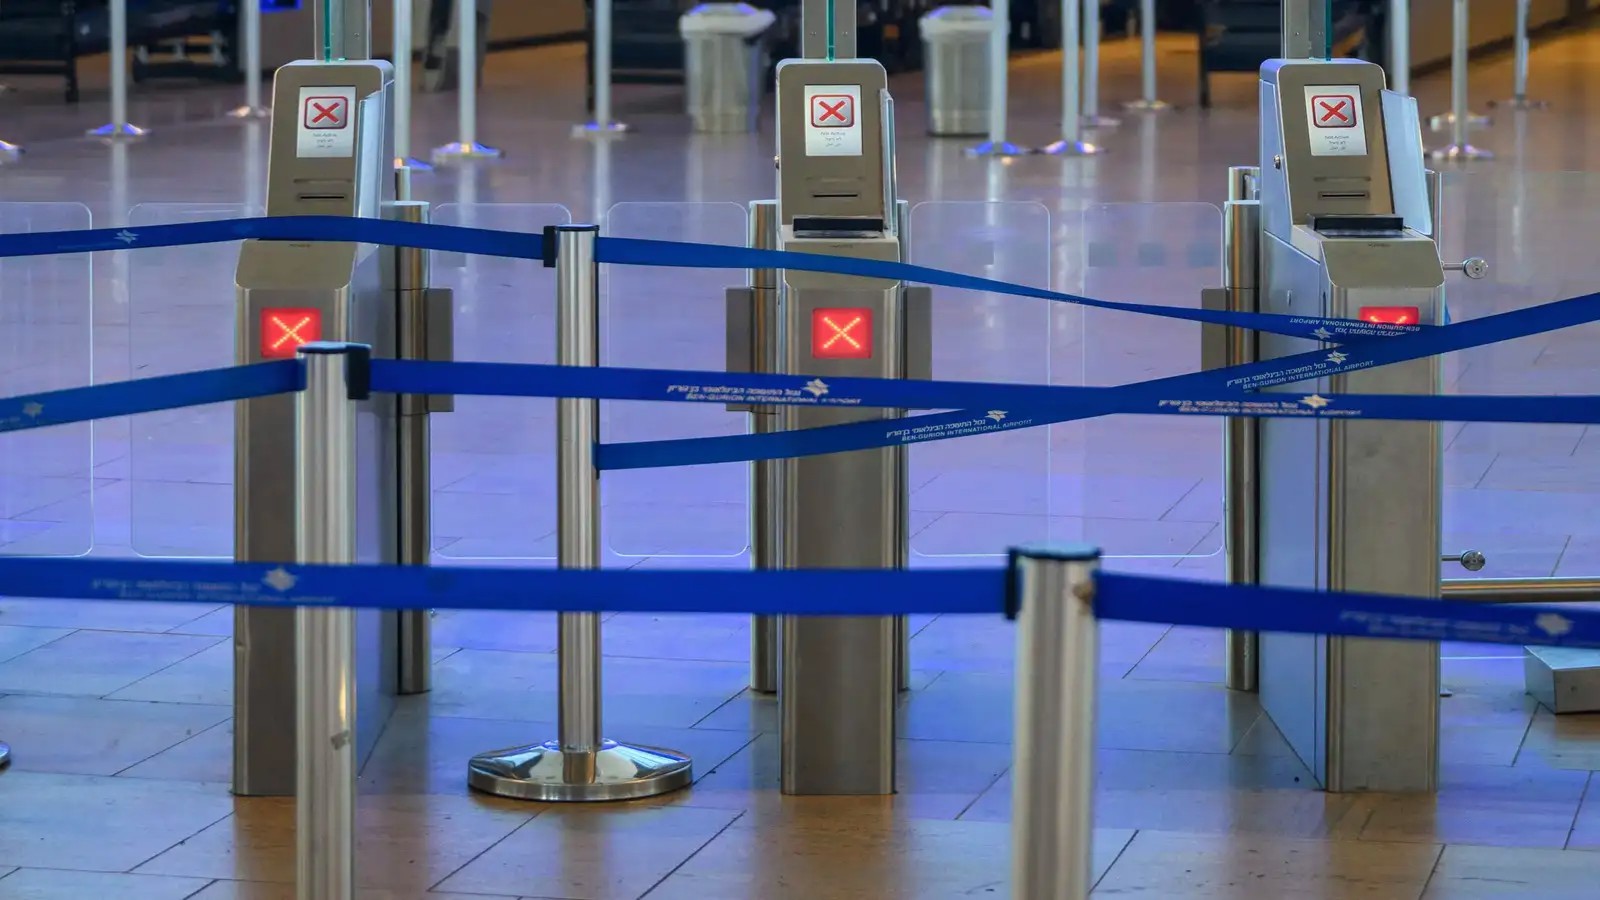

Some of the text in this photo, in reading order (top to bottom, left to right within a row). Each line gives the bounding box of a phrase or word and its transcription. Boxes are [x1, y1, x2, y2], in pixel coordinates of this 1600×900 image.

[1322, 320, 1377, 329] INTERNATIONAL
[1243, 360, 1374, 389] BEN-GURION INTERNATIONAL AIRPORT
[1252, 370, 1284, 380] הבינלאומי
[1285, 365, 1312, 375] התעופה
[901, 419, 1033, 441] BEN-GURION INTERNATIONAL AIRPORT
